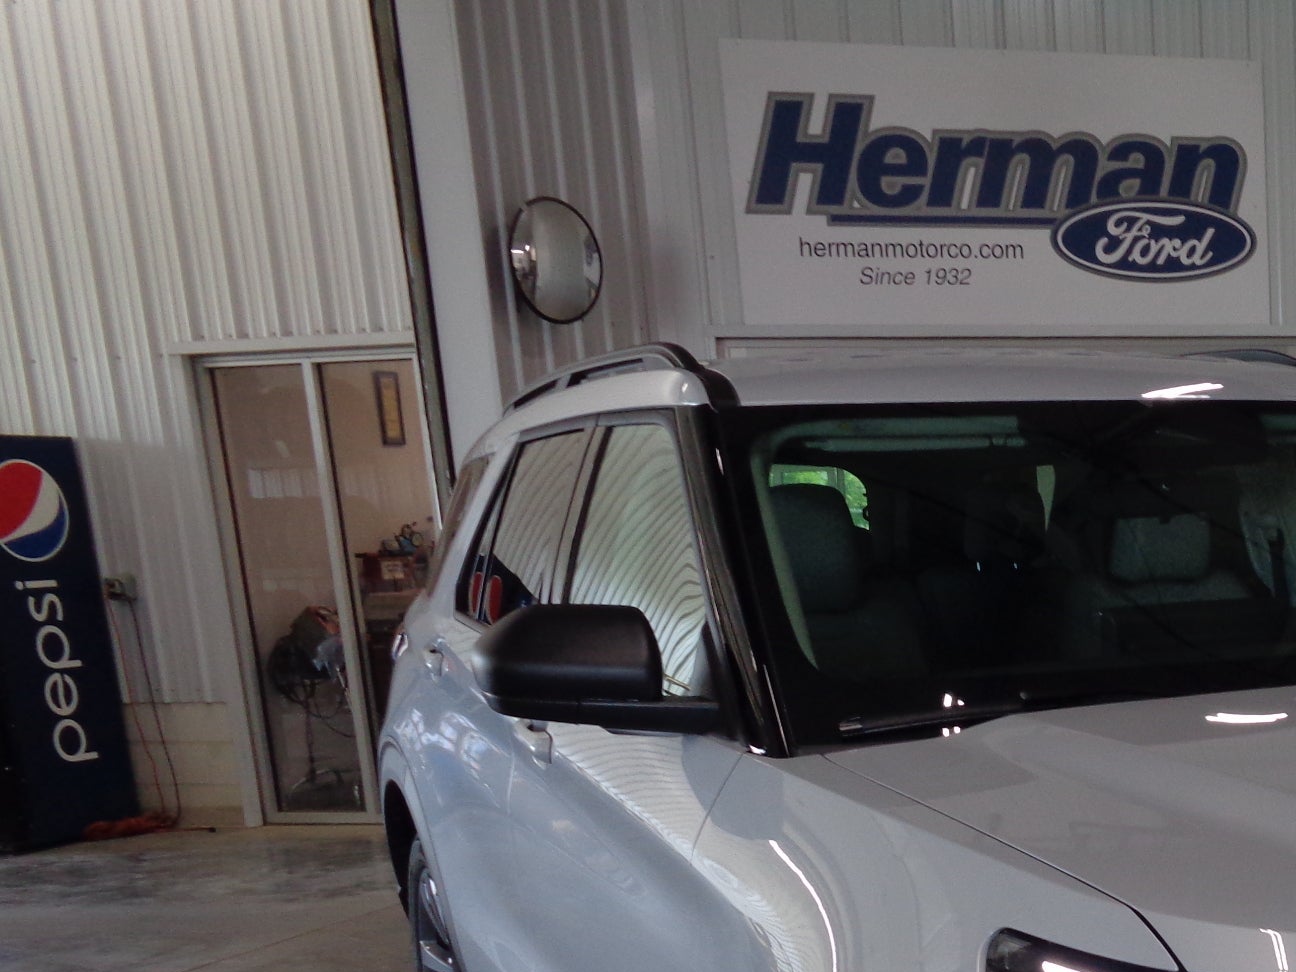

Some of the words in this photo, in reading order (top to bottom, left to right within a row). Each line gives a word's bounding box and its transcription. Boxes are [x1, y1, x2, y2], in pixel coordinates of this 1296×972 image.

[747, 92, 1247, 214] Herman
[799, 236, 1024, 260] hermanmotorco.com
[1094, 209, 1214, 267] Ford
[859, 266, 915, 286] Since
[925, 267, 972, 286] 1932
[15, 579, 99, 763] pepsi
